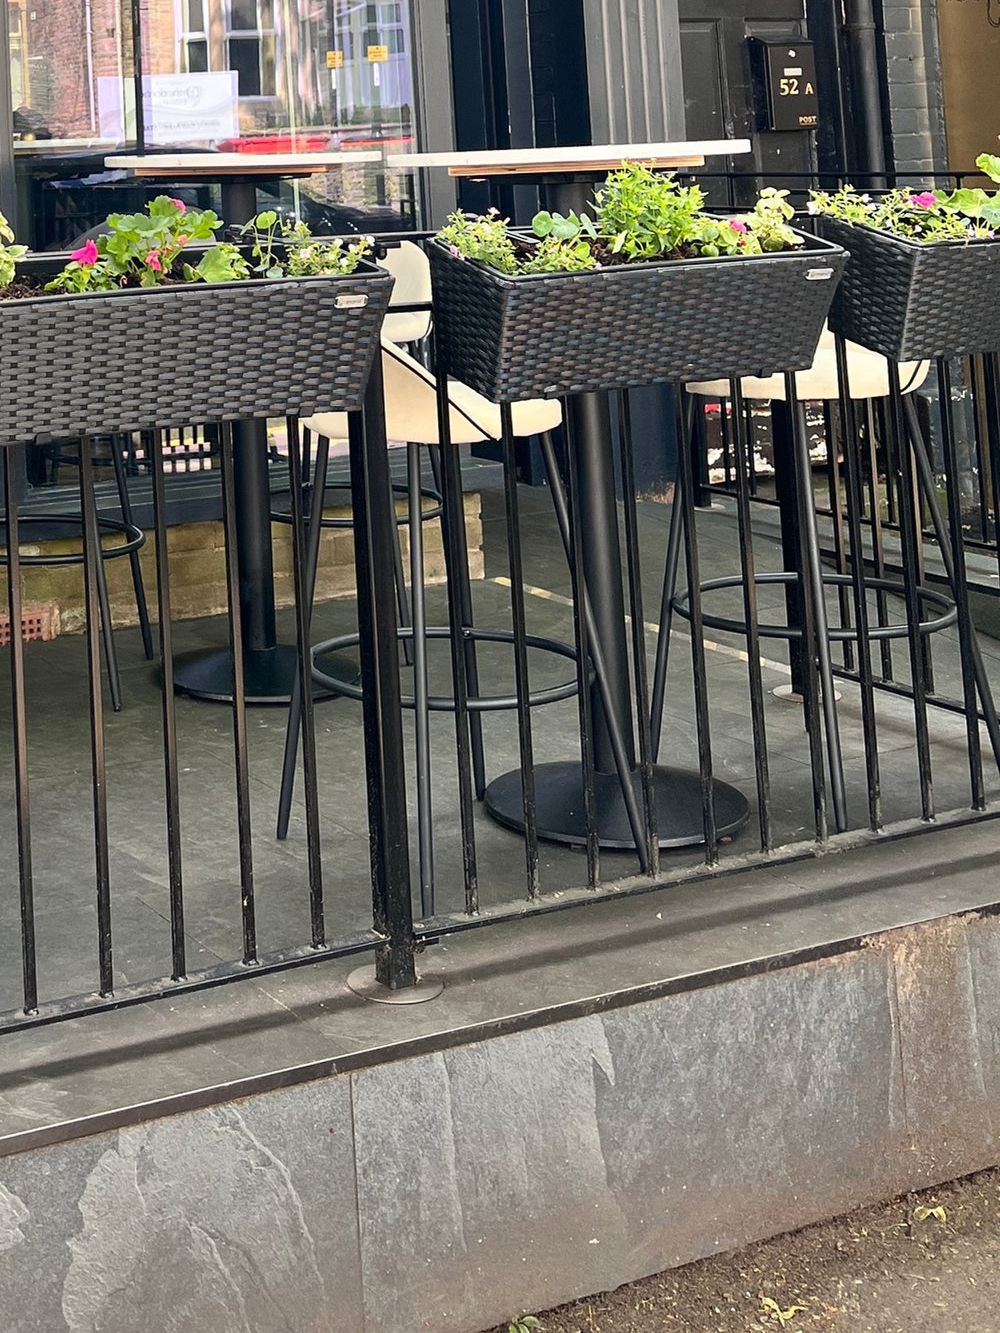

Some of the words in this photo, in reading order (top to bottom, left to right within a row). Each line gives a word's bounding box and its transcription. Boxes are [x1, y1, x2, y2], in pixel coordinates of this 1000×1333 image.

[779, 78, 799, 96] 52
[804, 82, 814, 95] A
[799, 115, 817, 124] POST
